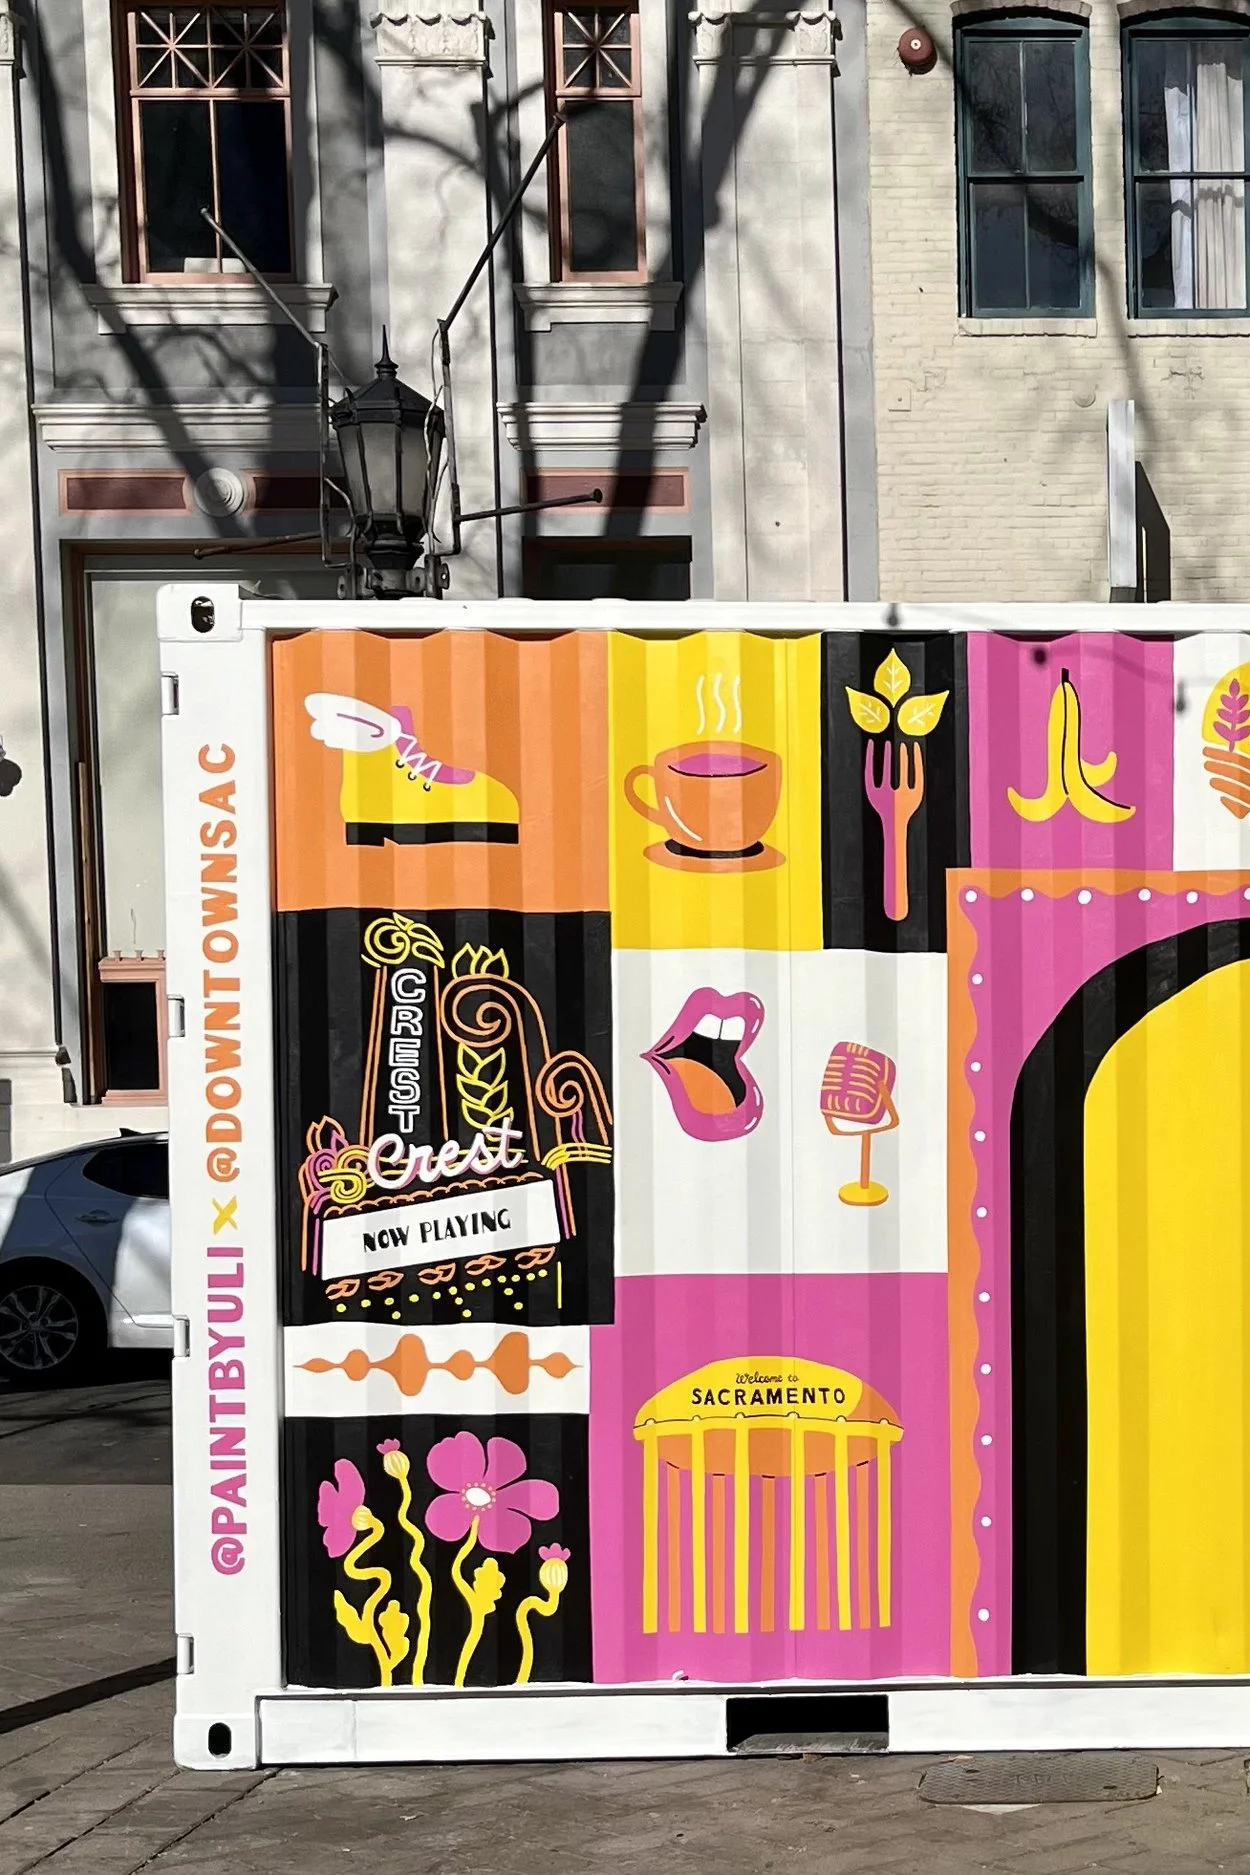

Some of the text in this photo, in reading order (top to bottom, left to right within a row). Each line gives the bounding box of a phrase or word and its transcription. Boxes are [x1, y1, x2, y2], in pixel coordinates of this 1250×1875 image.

[198, 743, 242, 1183] @DOWNTOWNSAC
[388, 968, 427, 1134] CREST
[367, 1116, 523, 1190] Crest
[362, 1208, 512, 1253] NOW PLAYING
[207, 1247, 247, 1576] @PAINTBYULI
[691, 1387, 846, 1406] SACRAMENTO
[735, 1371, 800, 1385] Welcome to
